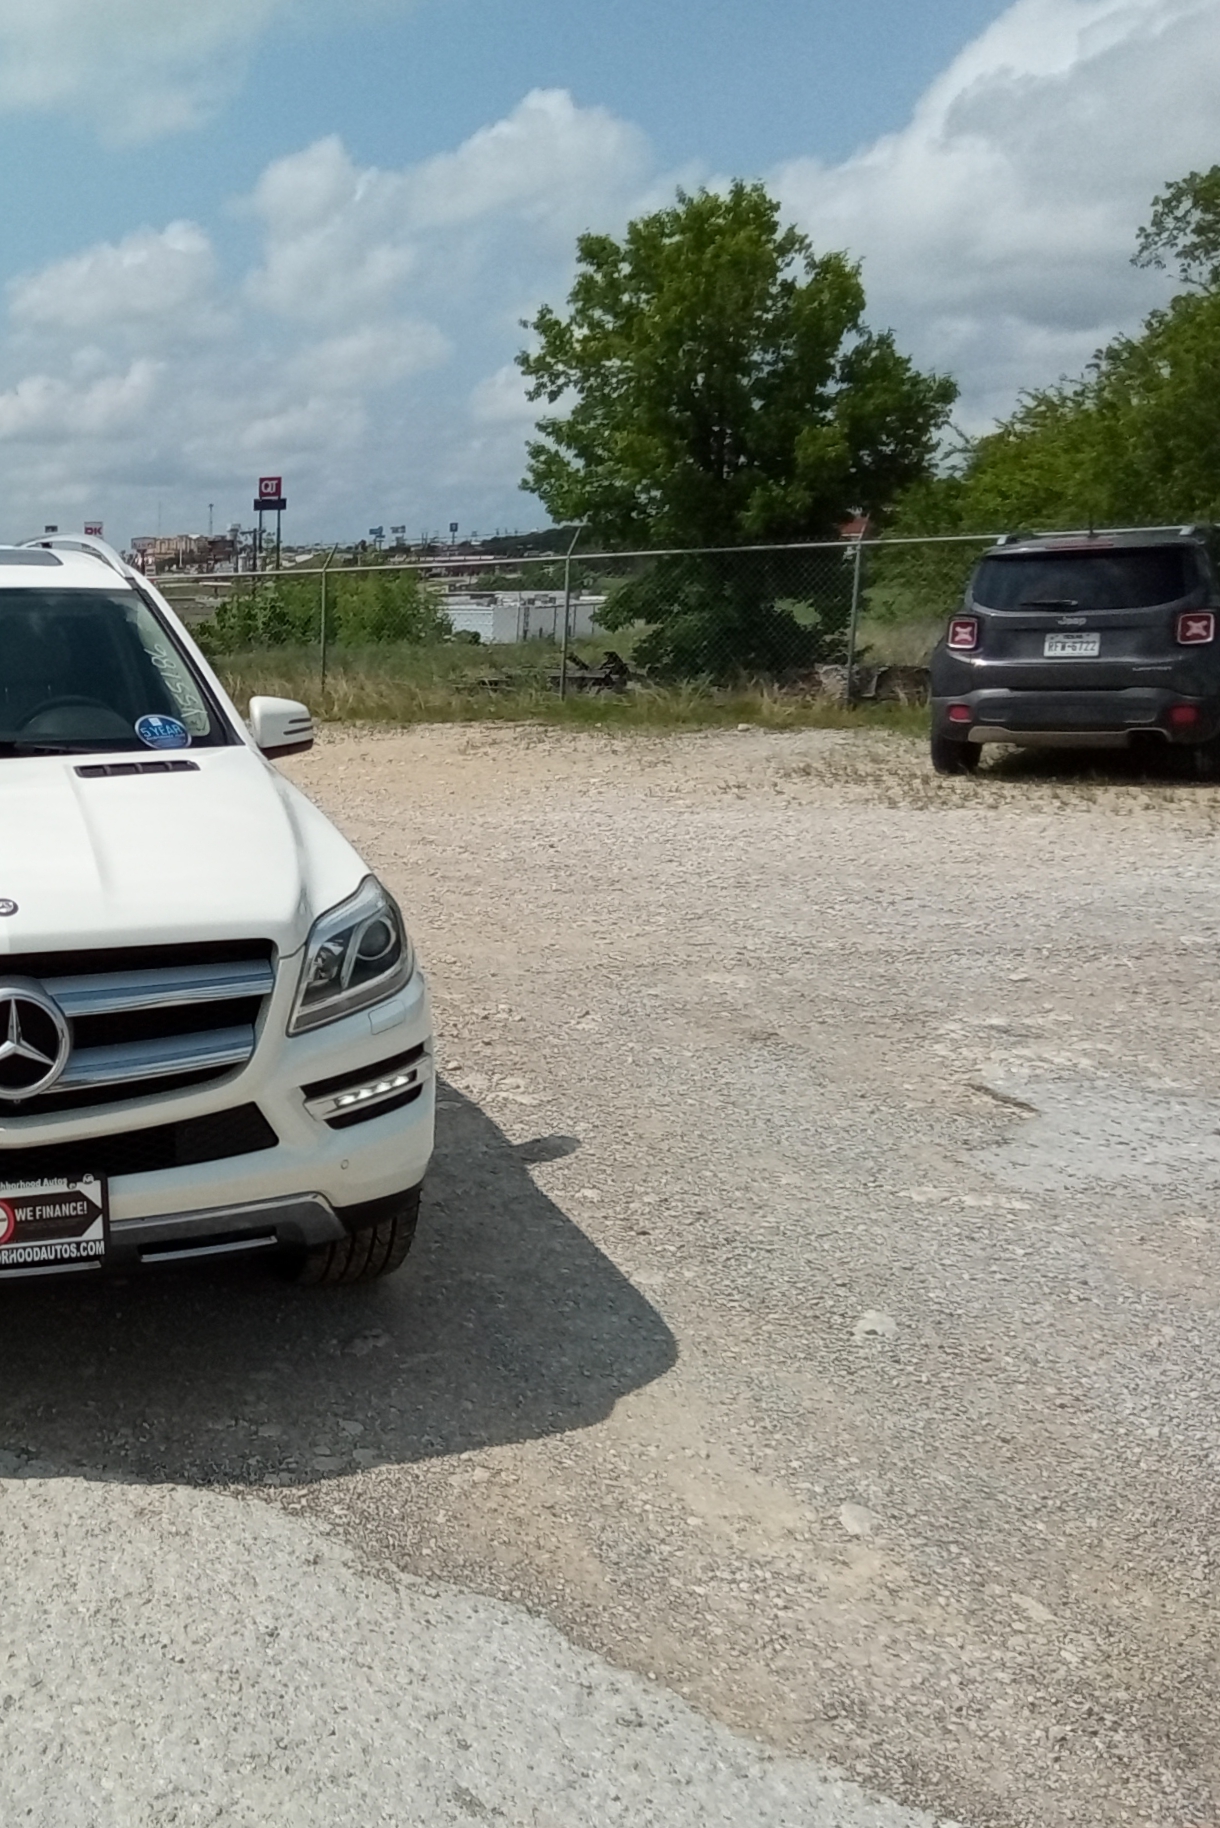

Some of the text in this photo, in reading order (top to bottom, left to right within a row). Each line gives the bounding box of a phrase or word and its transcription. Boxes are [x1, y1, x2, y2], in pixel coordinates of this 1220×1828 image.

[261, 480, 278, 494] QT
[1057, 616, 1087, 626] Jeep
[140, 727, 152, 738] 5
[149, 724, 183, 736] YEAR
[43, 1177, 68, 1189] Autos
[14, 1207, 34, 1222] WE
[36, 1201, 88, 1219] FINANCE!
